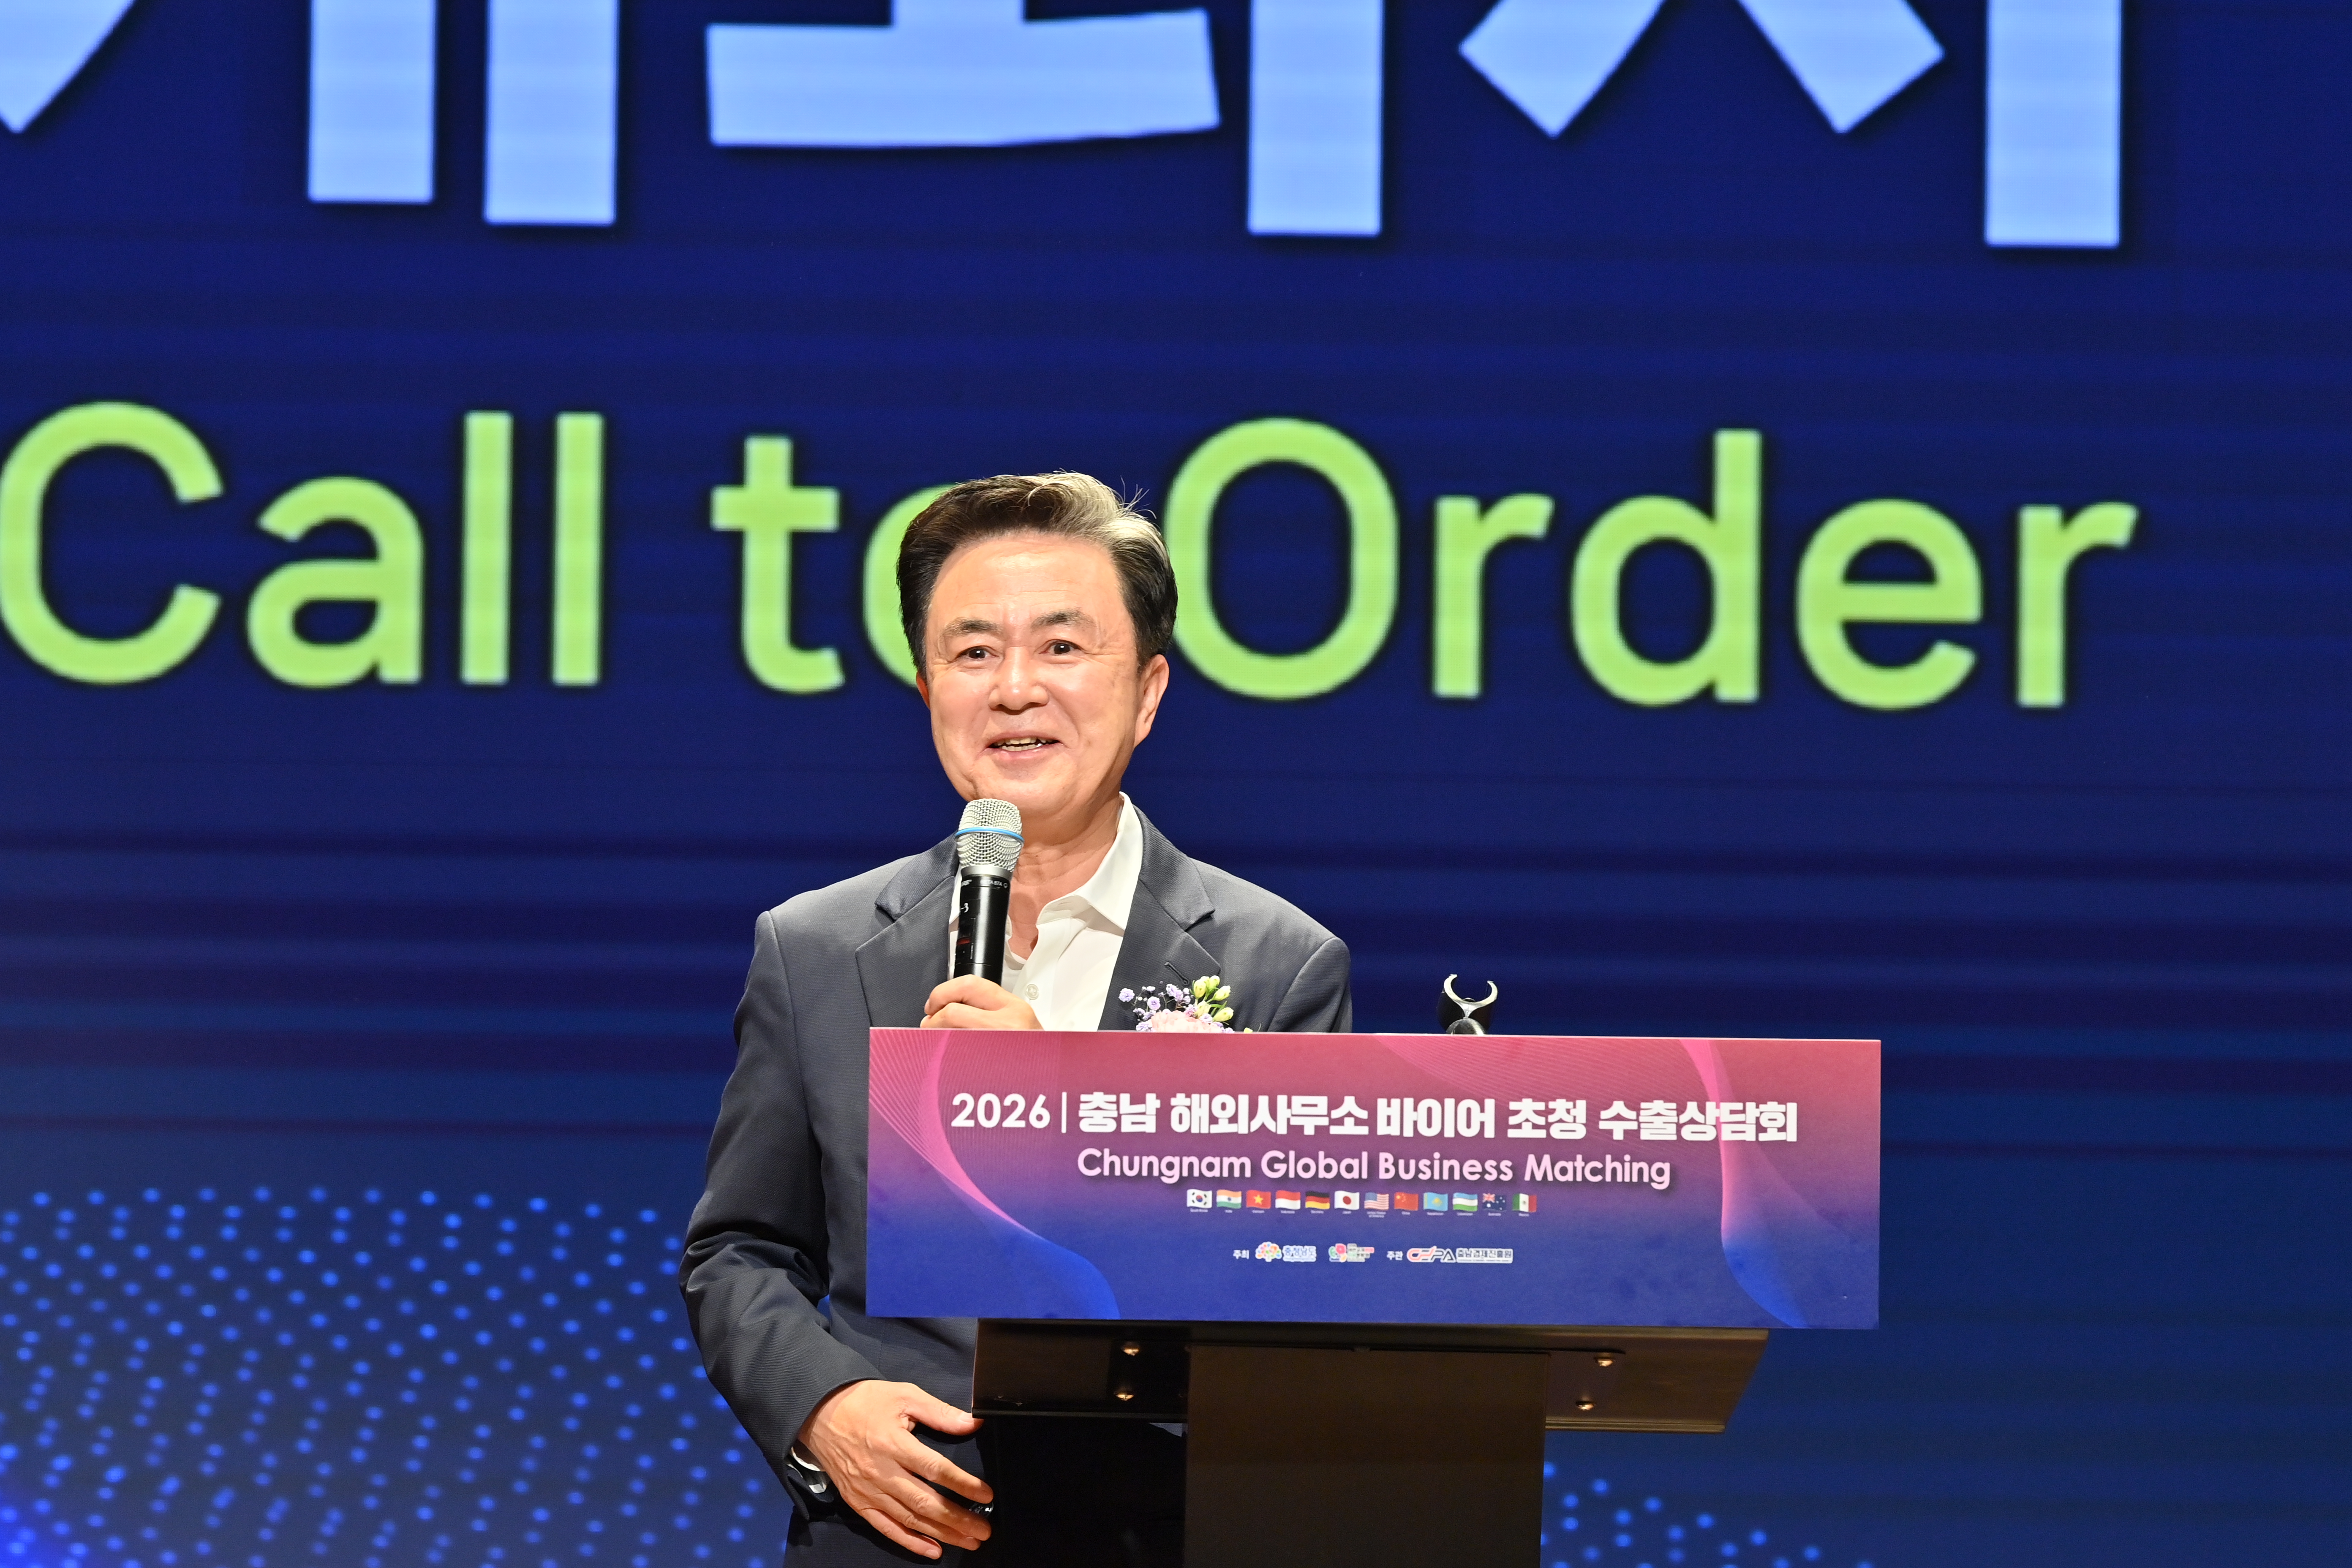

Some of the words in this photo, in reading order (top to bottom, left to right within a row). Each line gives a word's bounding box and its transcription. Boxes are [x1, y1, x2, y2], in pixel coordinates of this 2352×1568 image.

[0, 400, 605, 689] Call
[1162, 418, 2139, 710] Order
[950, 1092, 1051, 1129] 2026
[1078, 1092, 1161, 1133] 충남
[1171, 1093, 1369, 1135] 해외사무소
[1377, 1097, 1495, 1138] 바이어
[1507, 1098, 1587, 1140] 초청
[1599, 1100, 1797, 1142] 수출상담회
[1078, 1148, 1251, 1184] Chungnam
[1261, 1150, 1368, 1179] Global
[1379, 1152, 1513, 1181] Business
[1524, 1154, 1670, 1190] Matching
